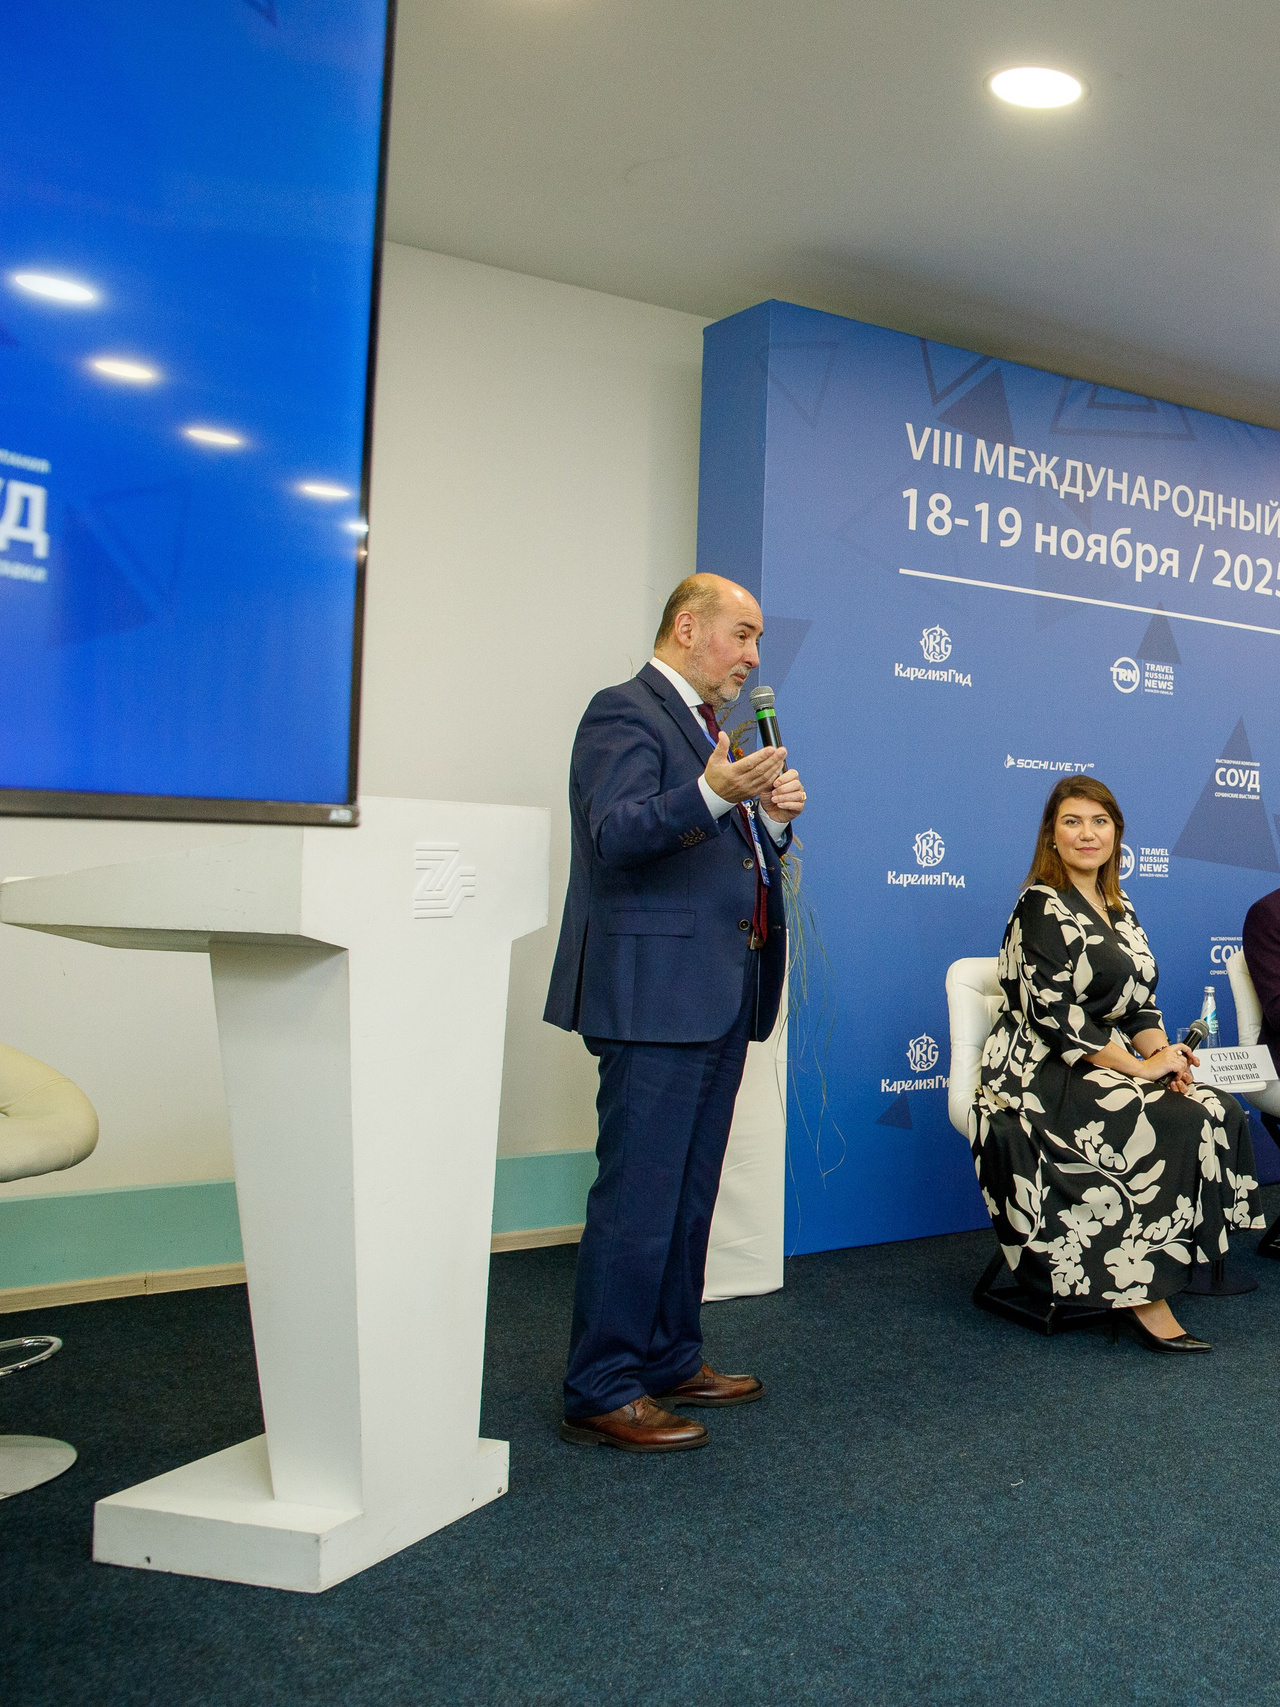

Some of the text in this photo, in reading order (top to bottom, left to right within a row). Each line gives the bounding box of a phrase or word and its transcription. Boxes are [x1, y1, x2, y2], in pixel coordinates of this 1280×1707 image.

[905, 423, 963, 469] VIII
[901, 487, 1023, 548] 18-19
[1034, 521, 1180, 582] ноября
[1109, 666, 1137, 683] TRN
[1145, 663, 1174, 674] TRAVEL
[894, 662, 973, 688] КарелияГид
[1144, 671, 1174, 682] RUSSIAN
[1144, 679, 1174, 690] NEWS
[1016, 759, 1049, 770] SOCHI
[1049, 761, 1087, 772] LIVE.TV
[1215, 767, 1260, 793] СОУД
[1140, 847, 1170, 856] TRAVEL
[1139, 863, 1169, 873] NEWS
[887, 870, 966, 888] КарелияГид
[1210, 1051, 1249, 1062] СТУПКО
[1210, 1062, 1258, 1073] Александра
[1213, 1072, 1261, 1084] Георгиевна
[881, 1077, 950, 1094] КарелияГи
